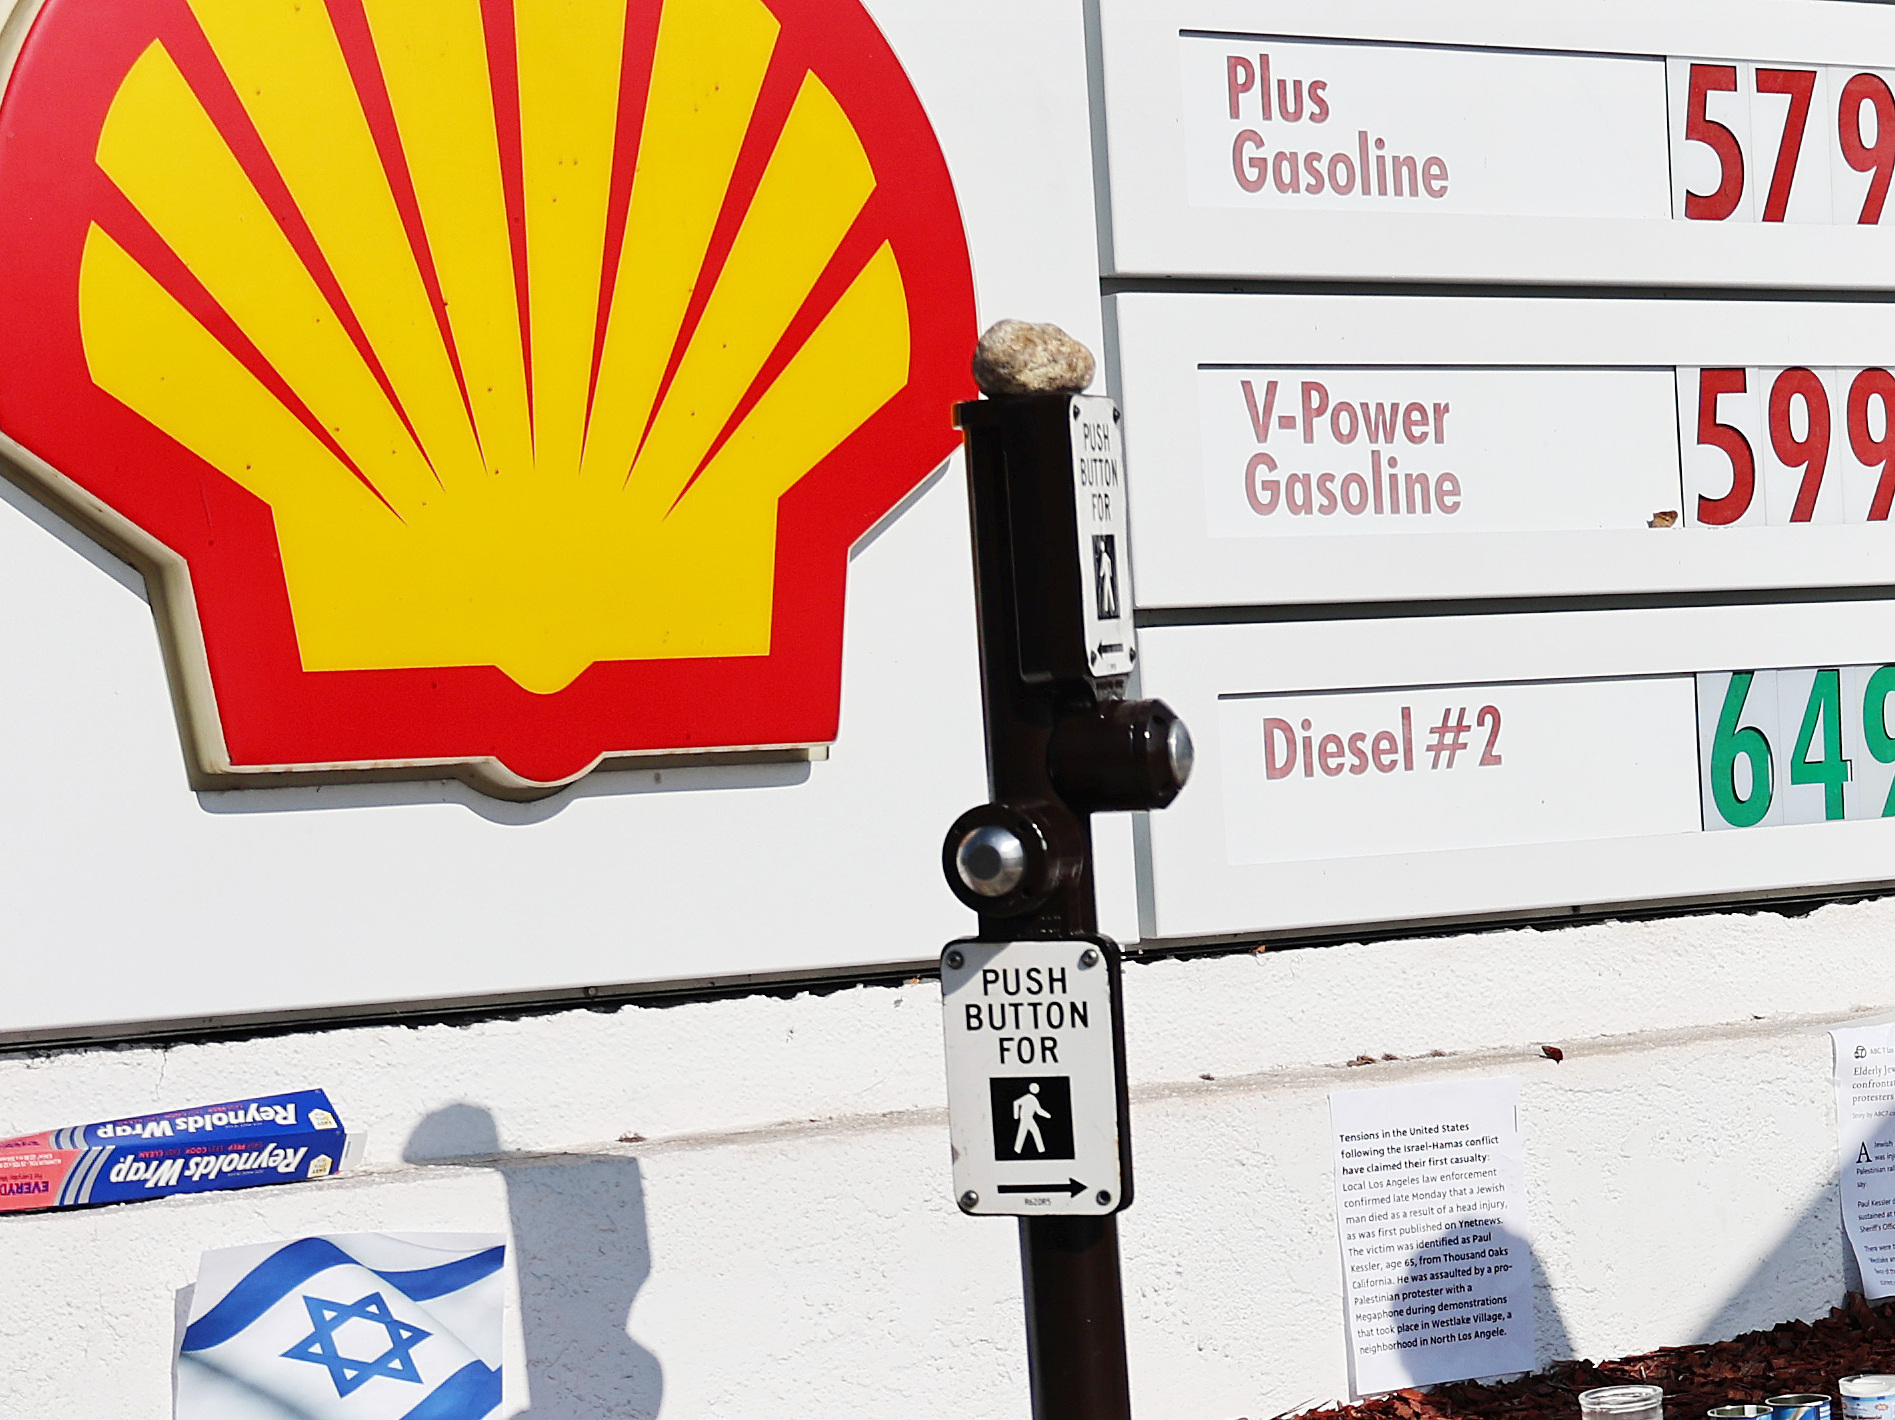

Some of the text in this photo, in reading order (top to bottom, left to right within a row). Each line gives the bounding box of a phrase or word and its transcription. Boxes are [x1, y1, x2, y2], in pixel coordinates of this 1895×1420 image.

[1226, 54, 1331, 124] Plus
[1231, 130, 1450, 200] Gasoline
[1240, 379, 1451, 448] V-Power
[1084, 423, 1110, 451] PUSH
[1081, 458, 1118, 487] BUTTON
[1244, 451, 1463, 519] Gasoline
[1092, 493, 1111, 522] FOR
[1264, 704, 1503, 782] Diesel #2
[982, 967, 1067, 996] PUSH
[965, 1001, 1088, 1031] BUTTON
[999, 1036, 1059, 1064] FOR
[1853, 1066, 1882, 1077] Elderly
[1852, 1091, 1894, 1105] protesters
[96, 1119, 174, 1139] Wrap
[174, 1102, 297, 1133] Reynolds
[1339, 1124, 1470, 1142] Tensions in the United States
[1341, 1136, 1499, 1158] following the Israel-Hamas conflict
[1856, 1141, 1872, 1163] A
[110, 1155, 185, 1188] Wrap
[183, 1143, 308, 1181] Reynolds
[1342, 1154, 1491, 1175] have claimed their first casualty:
[1343, 1169, 1497, 1191] Local Los Angeles law enforcement
[1344, 1195, 1391, 1208] confirmed
[1393, 1194, 1410, 1203] late
[1411, 1191, 1447, 1201] Monday
[1449, 1188, 1467, 1197] that
[1476, 1183, 1505, 1194] Jewish
[1345, 1216, 1367, 1224] man
[1368, 1212, 1388, 1222] died
[1390, 1212, 1400, 1220] as
[1409, 1208, 1434, 1218] result
[1436, 1206, 1446, 1215] of
[1456, 1203, 1477, 1213] head
[1479, 1202, 1508, 1212] injury,
[1358, 1231, 1375, 1239] was
[1378, 1228, 1397, 1237] first
[1399, 1222, 1442, 1237] published
[1458, 1218, 1504, 1229] Ynetnews.
[1348, 1233, 1492, 1256] The victim was identified as Paul
[1350, 1248, 1509, 1273] Kessler, age 65, from Thousand Oaks
[1352, 1278, 1395, 1290] California.
[1397, 1276, 1409, 1284] He
[1411, 1274, 1428, 1283] was
[1429, 1267, 1472, 1280] assaulted
[1474, 1267, 1485, 1277] by
[1494, 1265, 1513, 1275] pro-
[1354, 1293, 1400, 1305] Palestinian
[1402, 1289, 1443, 1302] protester
[1446, 1285, 1465, 1295] with
[1355, 1297, 1508, 1323] Megaphone during demonstrations
[1357, 1329, 1374, 1338] that
[1376, 1325, 1395, 1336] took
[1397, 1324, 1419, 1335] place
[1421, 1322, 1430, 1330] in
[1432, 1316, 1471, 1329] Westlake
[1473, 1314, 1505, 1324] Village,
[1359, 1328, 1507, 1355] neighborhood in North Los Angele.
